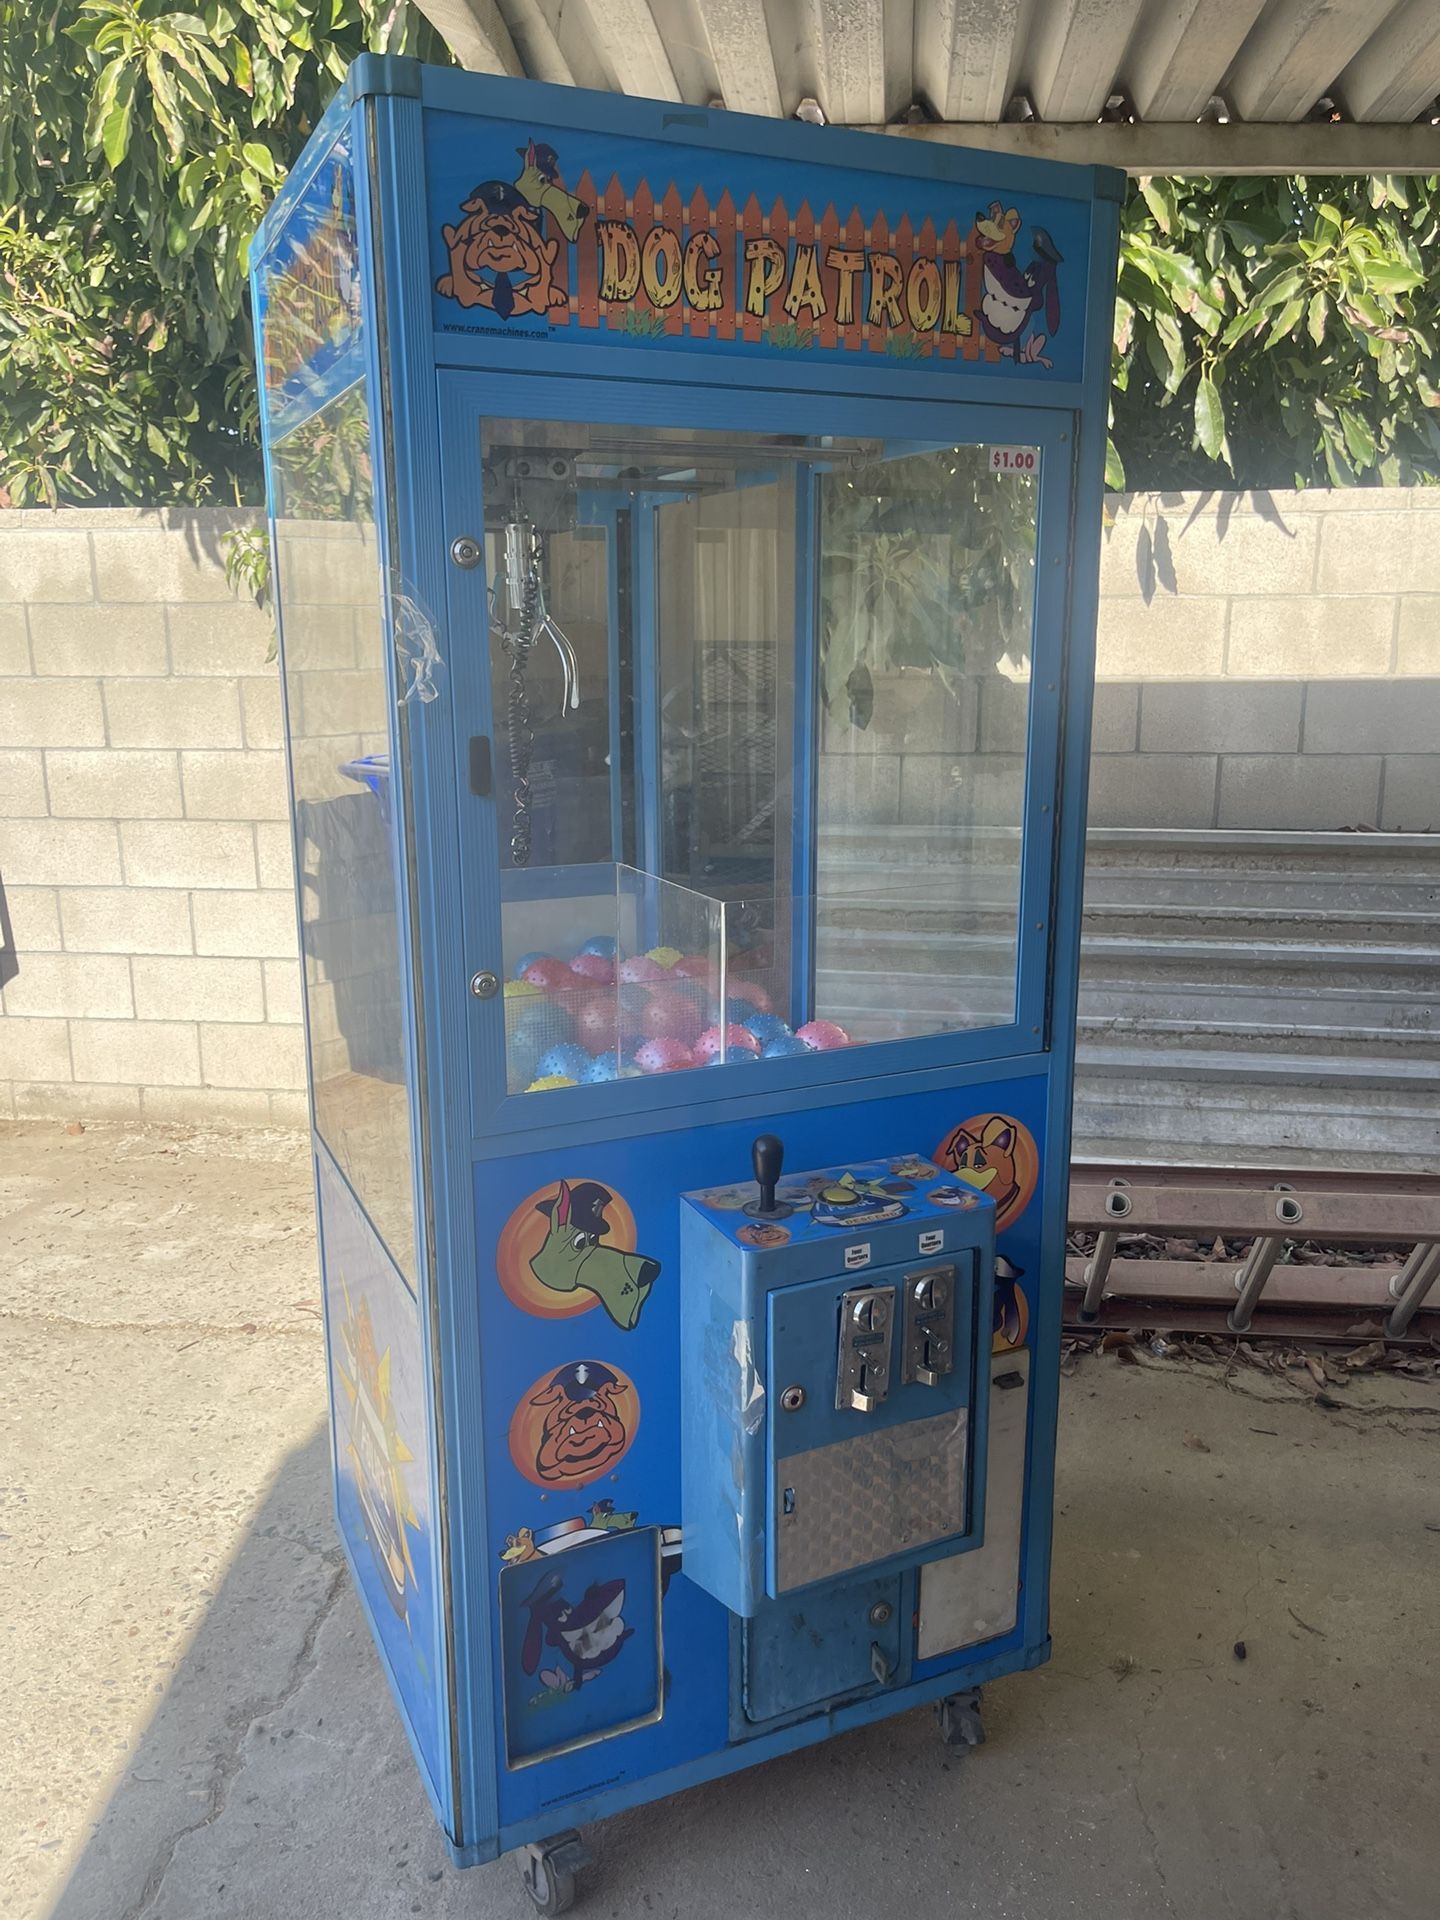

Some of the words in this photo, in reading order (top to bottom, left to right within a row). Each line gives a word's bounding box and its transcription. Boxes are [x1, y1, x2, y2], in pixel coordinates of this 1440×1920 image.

[595, 220, 724, 312] DOG
[744, 237, 973, 337] PATROL
[993, 451, 1034, 469] $1.00
